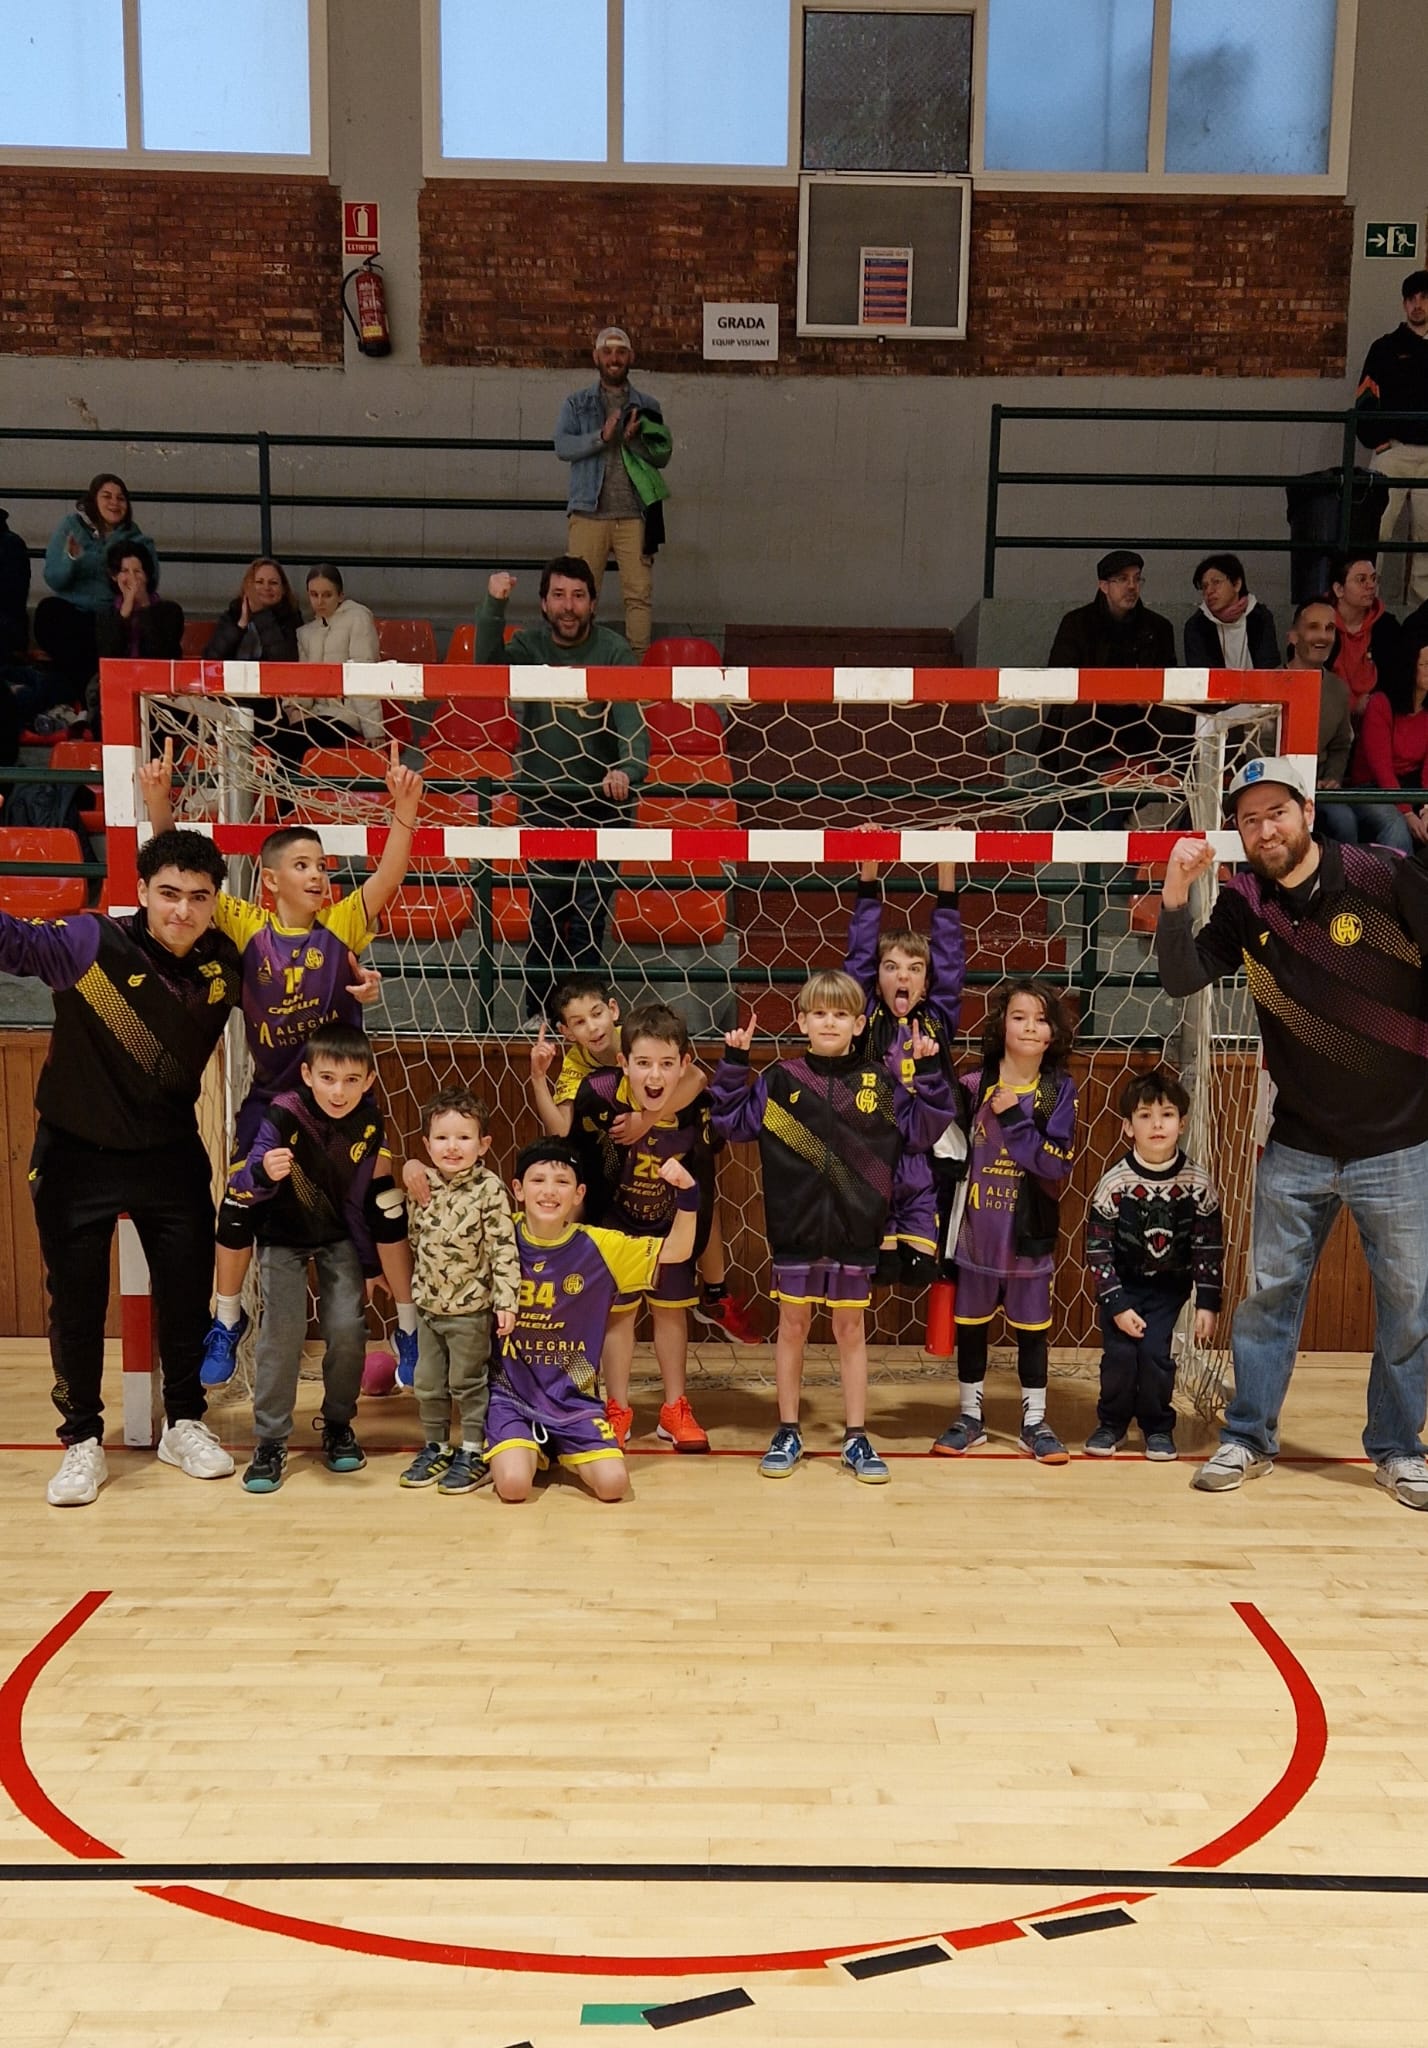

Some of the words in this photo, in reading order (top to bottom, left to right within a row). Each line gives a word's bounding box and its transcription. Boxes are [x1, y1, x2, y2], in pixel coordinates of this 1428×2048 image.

[717, 316, 766, 329] GRADA
[711, 339, 735, 347] EQUIP
[736, 339, 770, 347] VISITANT
[986, 1185, 1019, 1200] ALEG
[985, 1199, 1016, 1212] HOTE
[515, 1320, 566, 1330] ALELLA
[524, 1355, 571, 1365] OTELS
